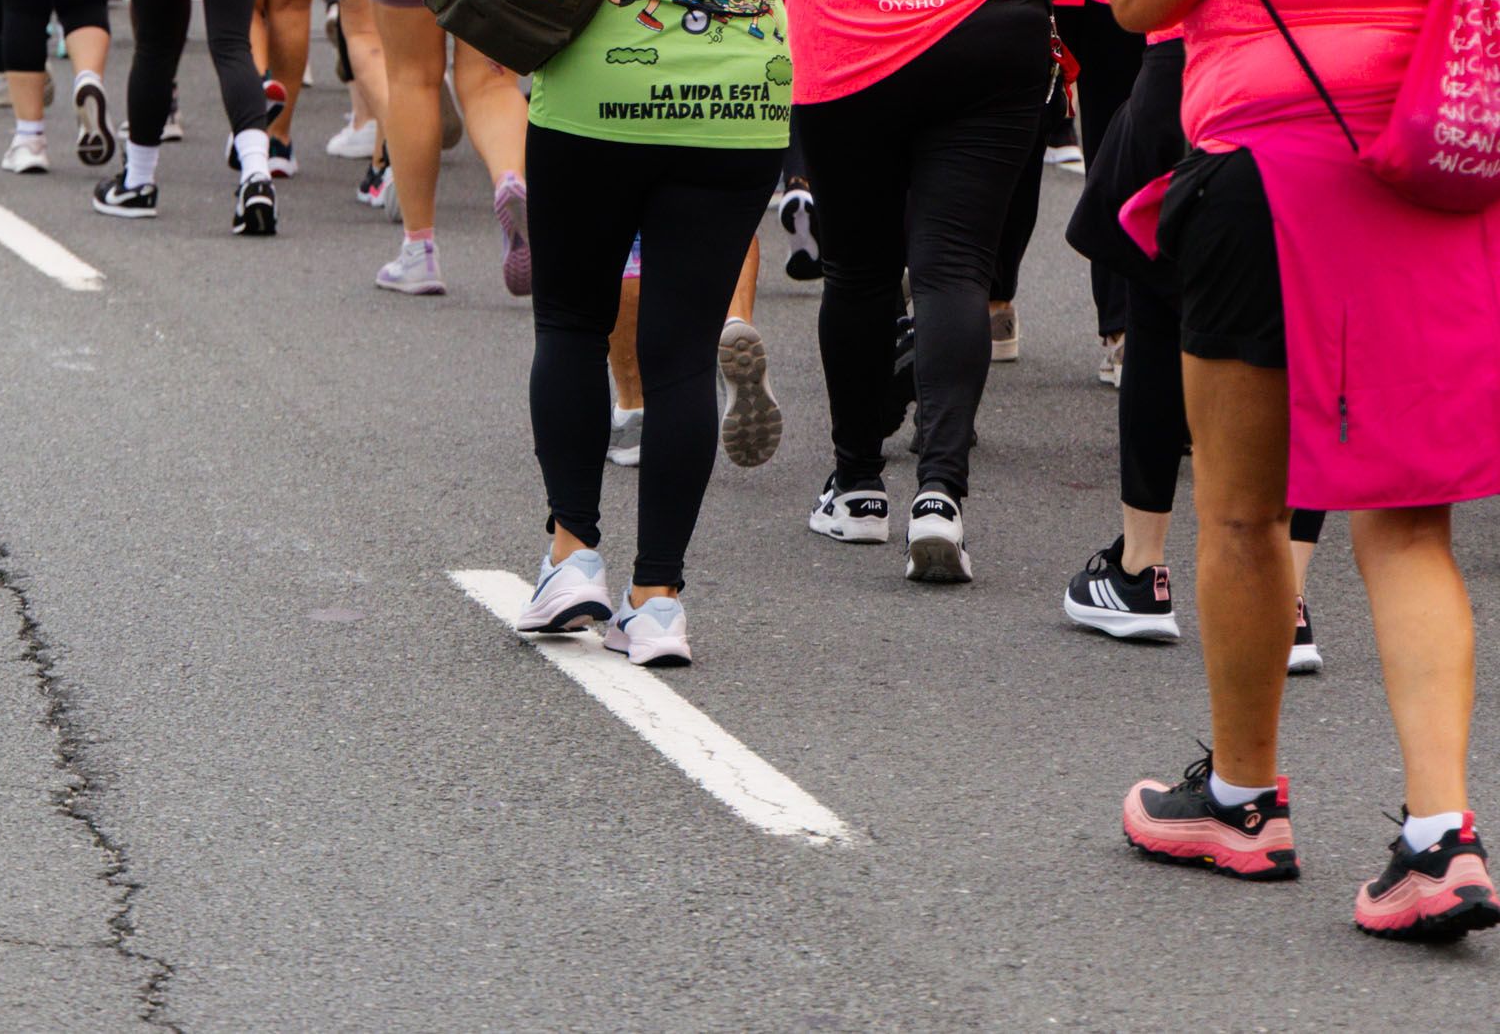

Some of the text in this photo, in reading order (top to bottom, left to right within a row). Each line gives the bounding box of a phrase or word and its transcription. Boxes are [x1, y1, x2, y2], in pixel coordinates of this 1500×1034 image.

[650, 84, 674, 101] LA
[679, 84, 724, 101] VIDA
[599, 102, 705, 120] INVENTADA
[710, 102, 756, 120] PARA
[860, 499, 882, 510] AIR
[920, 499, 943, 511] AIR
